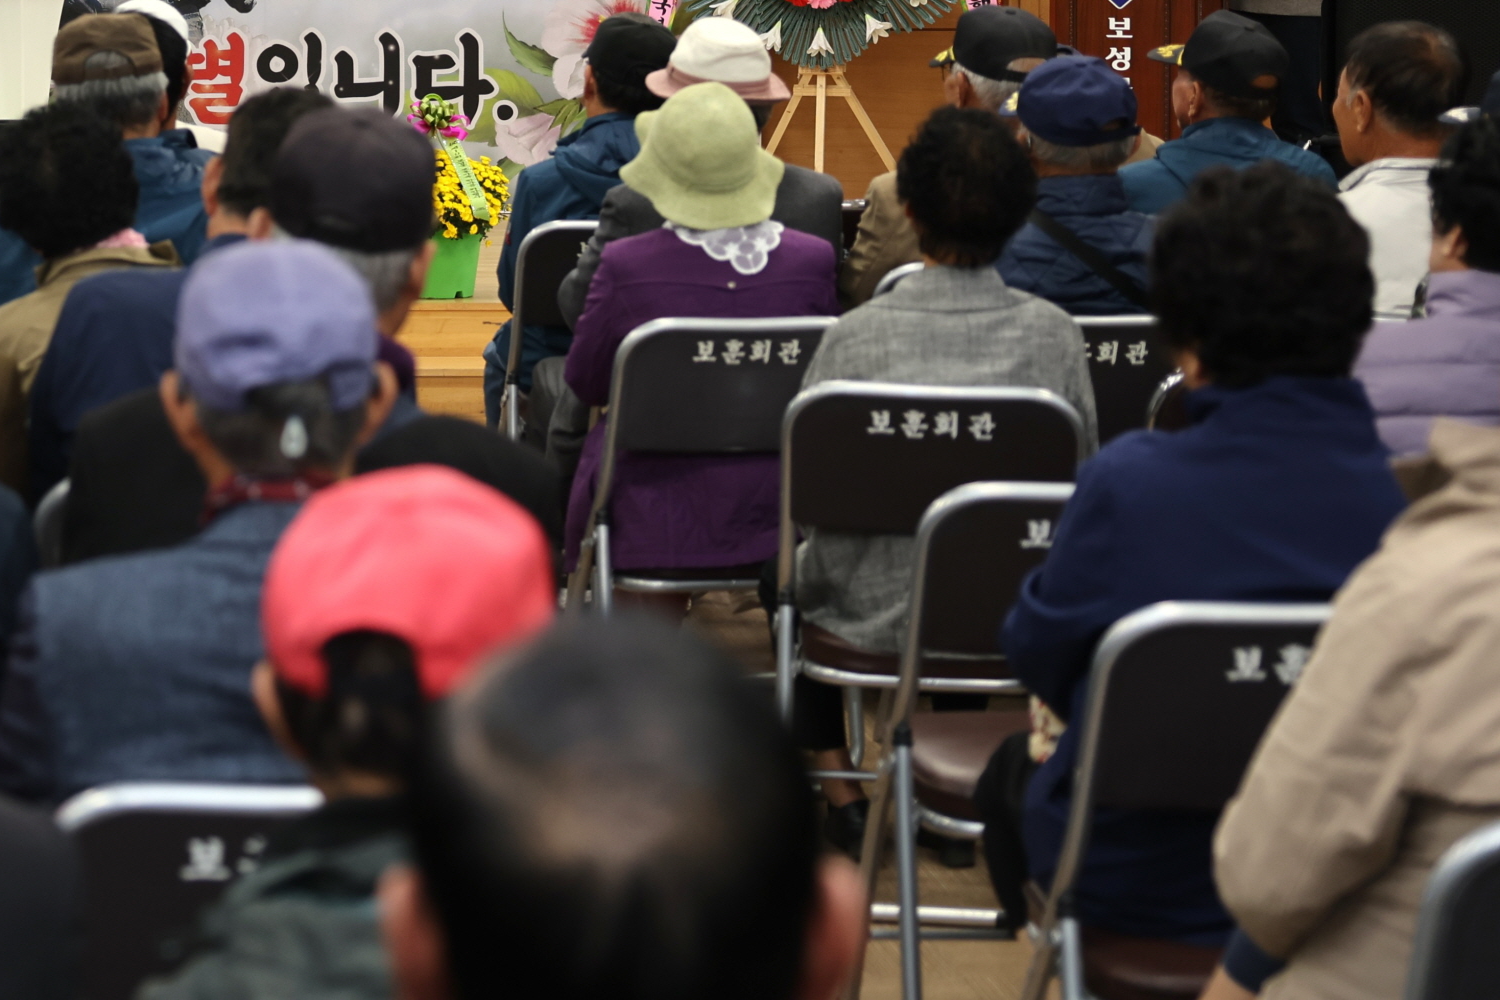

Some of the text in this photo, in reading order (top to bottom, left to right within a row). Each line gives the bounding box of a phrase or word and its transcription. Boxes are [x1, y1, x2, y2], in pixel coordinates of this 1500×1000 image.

[1105, 17, 1134, 90] 보성
[692, 339, 801, 365] 보훈회관
[866, 409, 998, 440] 보훈회관
